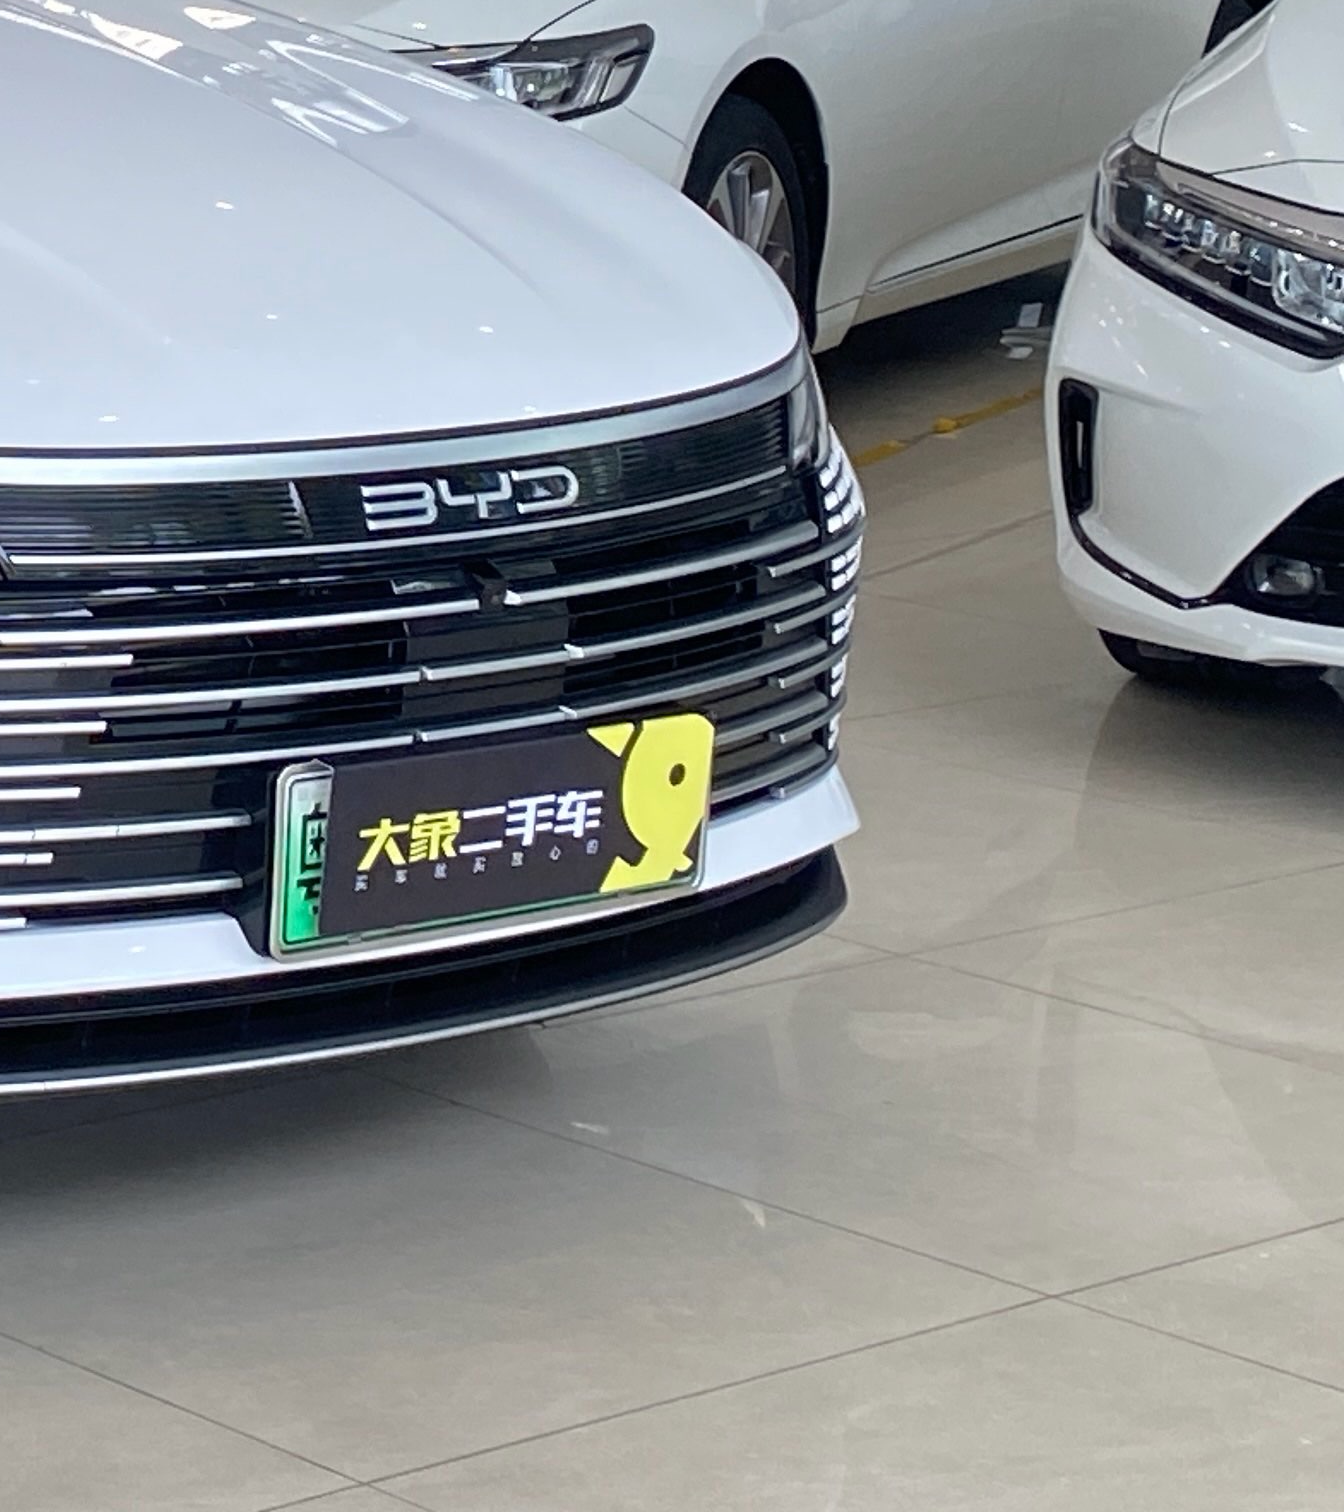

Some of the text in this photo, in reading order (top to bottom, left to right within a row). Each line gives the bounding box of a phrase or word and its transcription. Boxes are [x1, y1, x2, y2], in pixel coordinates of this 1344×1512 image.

[360, 465, 579, 531] BYD
[357, 789, 604, 872] 大象二手车
